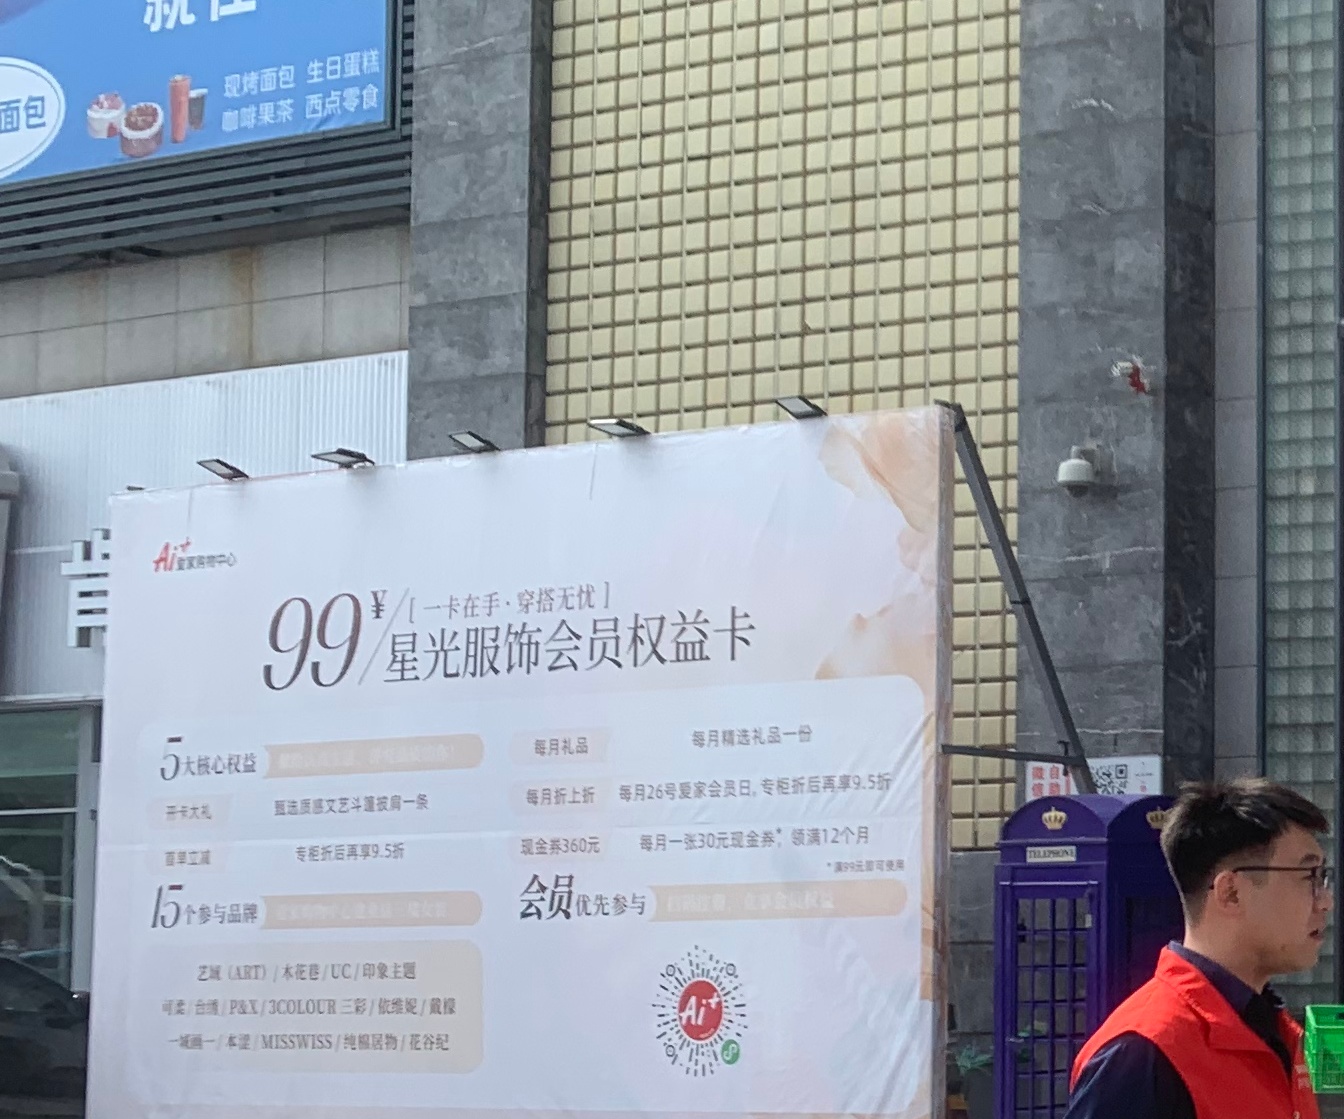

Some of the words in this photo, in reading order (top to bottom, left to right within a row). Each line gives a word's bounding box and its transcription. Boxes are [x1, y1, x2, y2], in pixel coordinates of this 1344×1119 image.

[223, 65, 296, 99] 现烤面包
[306, 48, 380, 85] 生日蛋糕
[221, 98, 294, 132] 咖啡果茶
[305, 84, 379, 120] 西点零食
[384, 605, 757, 683] 星光服饰会员权益卡
[534, 736, 589, 757] 每月礼品
[691, 724, 813, 749] 每月精选礼品一份
[526, 786, 596, 807] 每月折上折
[165, 803, 213, 822] 开卡大礼
[295, 841, 406, 863] 专柜折后再享9.5折
[520, 835, 601, 856] 现金券360元
[331, 962, 352, 980] UC
[363, 961, 416, 980] 印象主题
[268, 998, 337, 1015] 3COLOUR
[261, 1033, 333, 1050] MISSWISS
